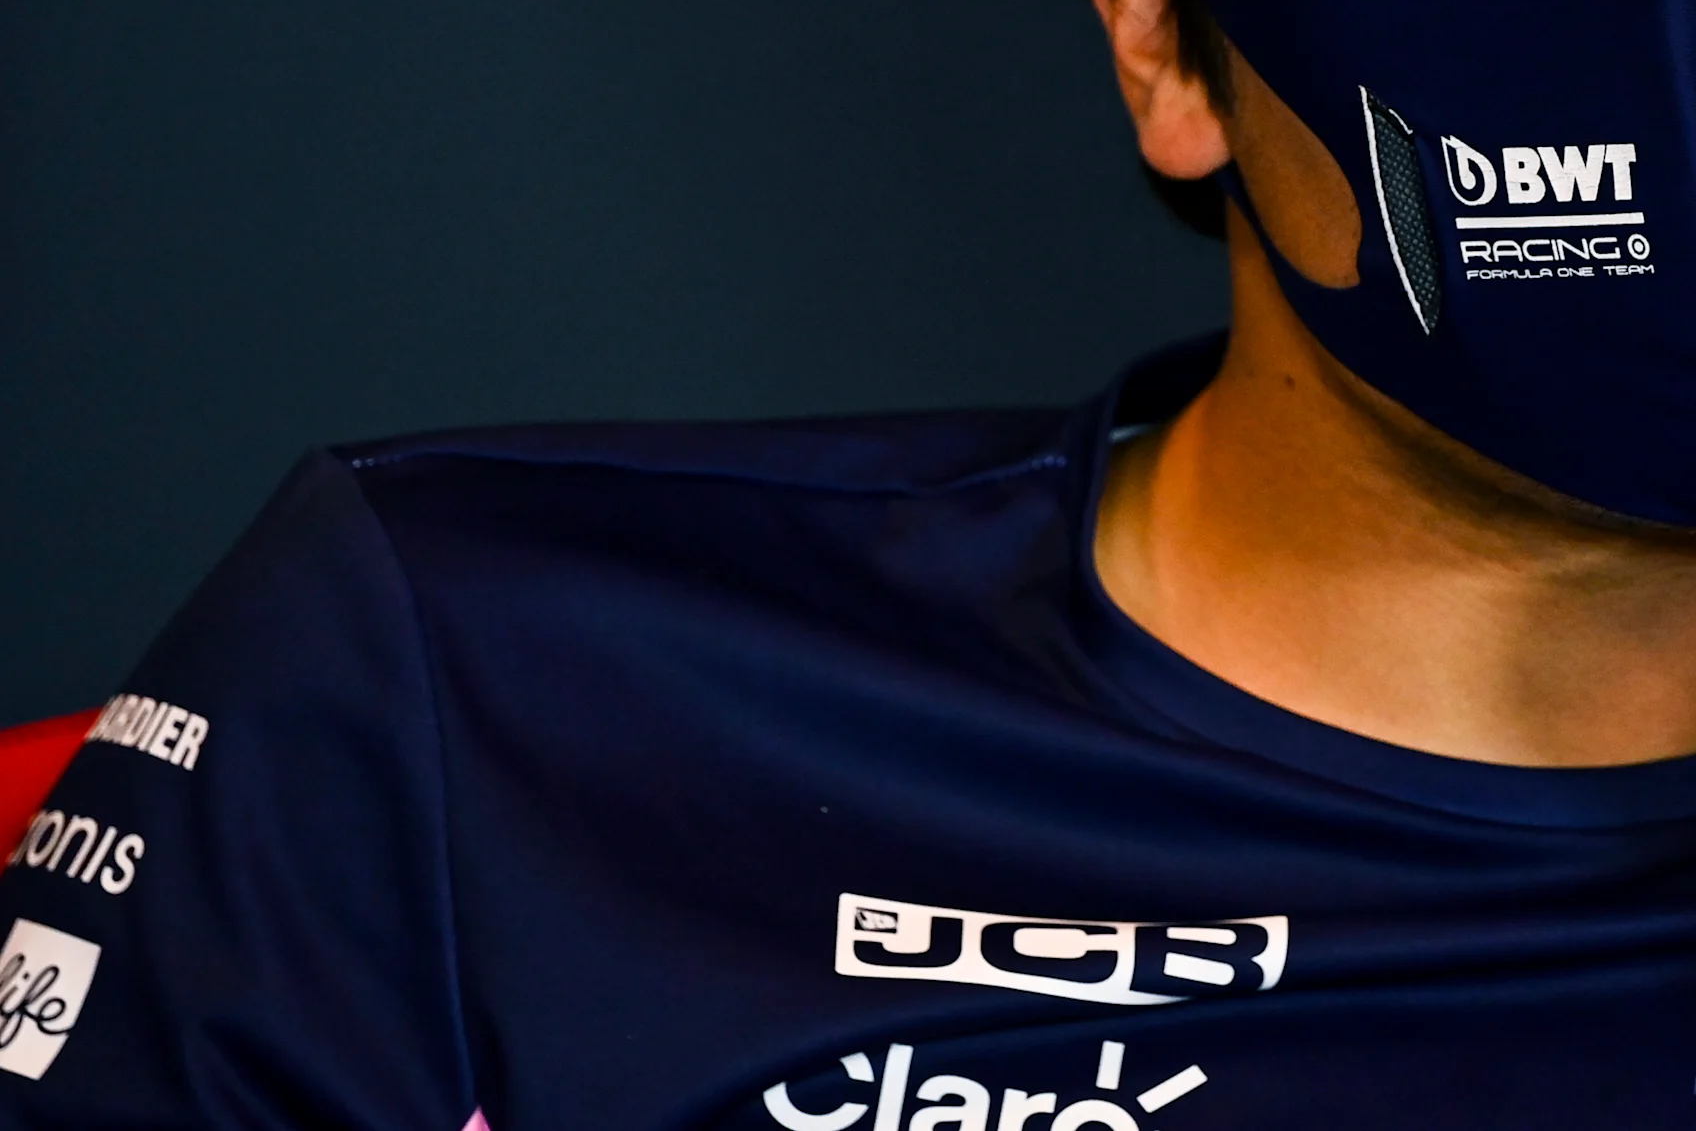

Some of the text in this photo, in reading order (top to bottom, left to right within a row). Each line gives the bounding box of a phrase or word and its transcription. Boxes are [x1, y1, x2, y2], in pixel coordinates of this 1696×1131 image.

[1502, 143, 1636, 204] BWT
[1460, 237, 1621, 263] RACING
[1466, 264, 1655, 280] FORMULA ONE TEAM
[853, 916, 1268, 993] JCB
